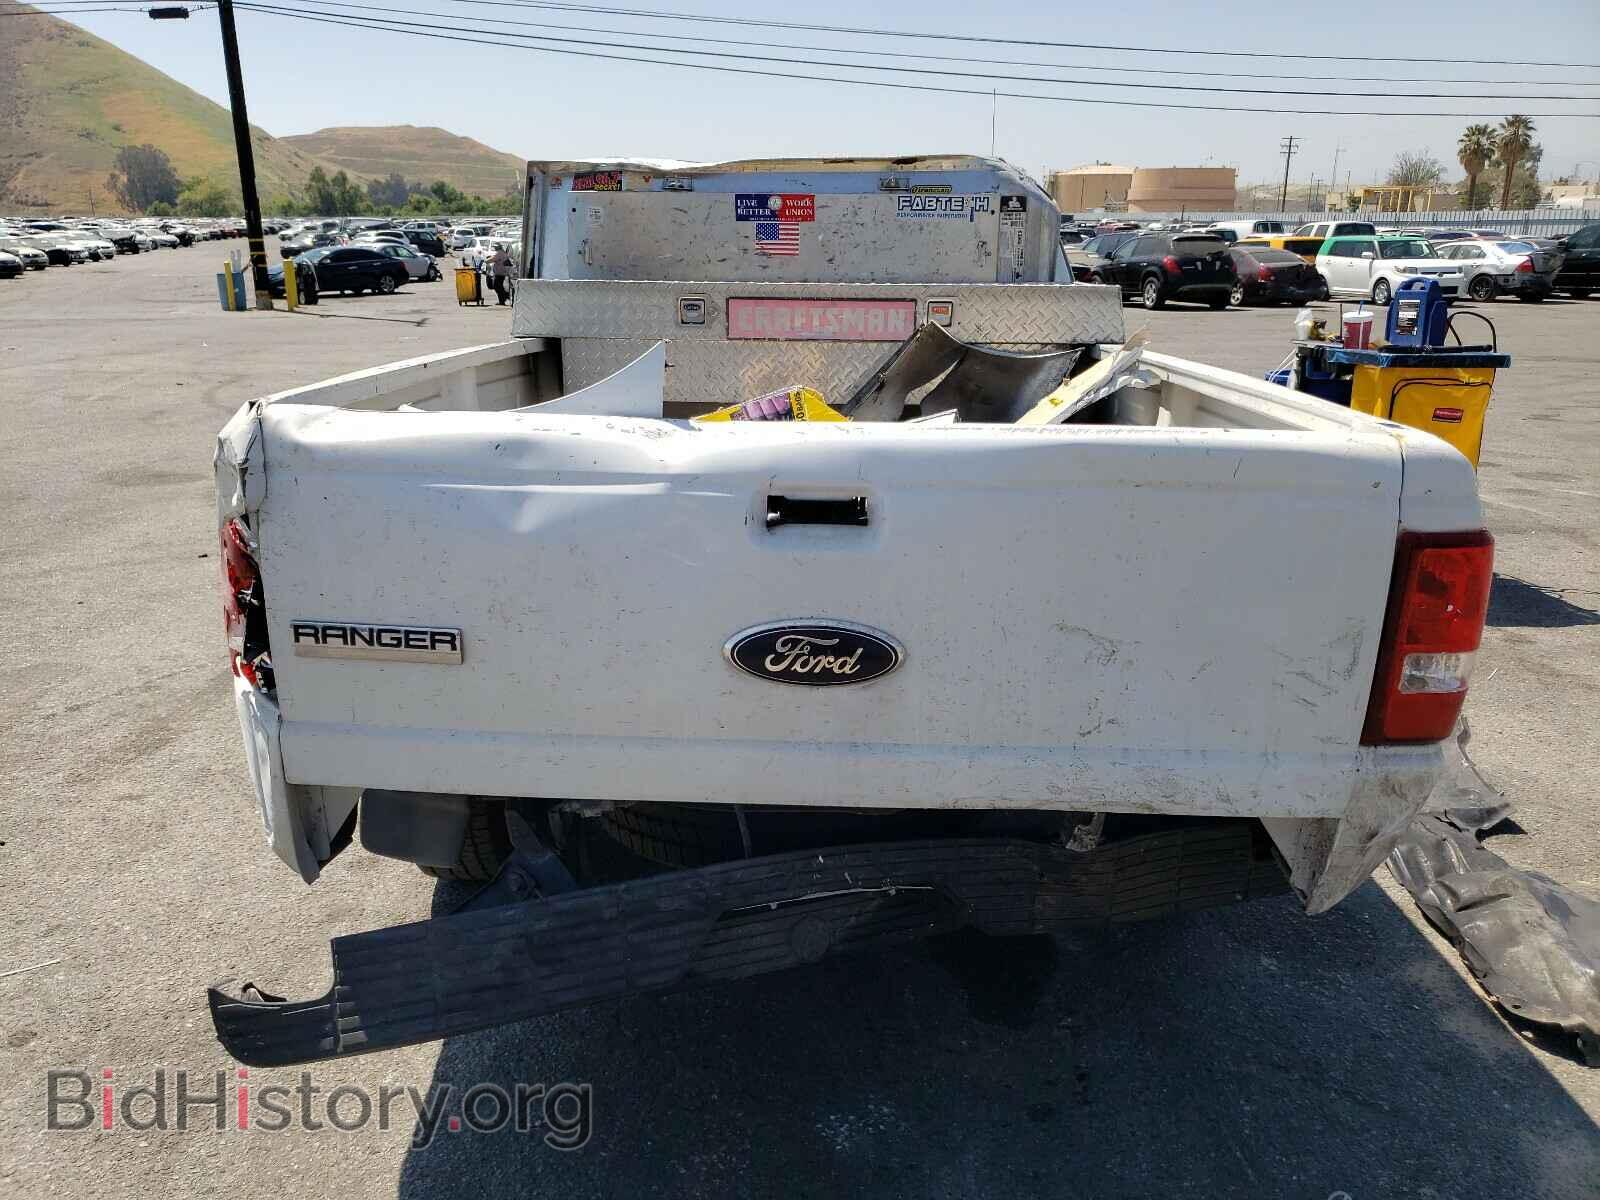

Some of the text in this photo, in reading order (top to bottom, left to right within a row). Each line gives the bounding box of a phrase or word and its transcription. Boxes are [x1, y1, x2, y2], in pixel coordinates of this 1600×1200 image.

[737, 199, 758, 207] LIVE
[785, 197, 812, 207] WORK
[897, 195, 990, 212] FABTEH
[737, 208, 771, 216] BETTER
[785, 208, 813, 216] UNION
[737, 307, 909, 333] CRAFTSMAN
[293, 623, 458, 651] RANGER
[764, 634, 864, 674] Ford
